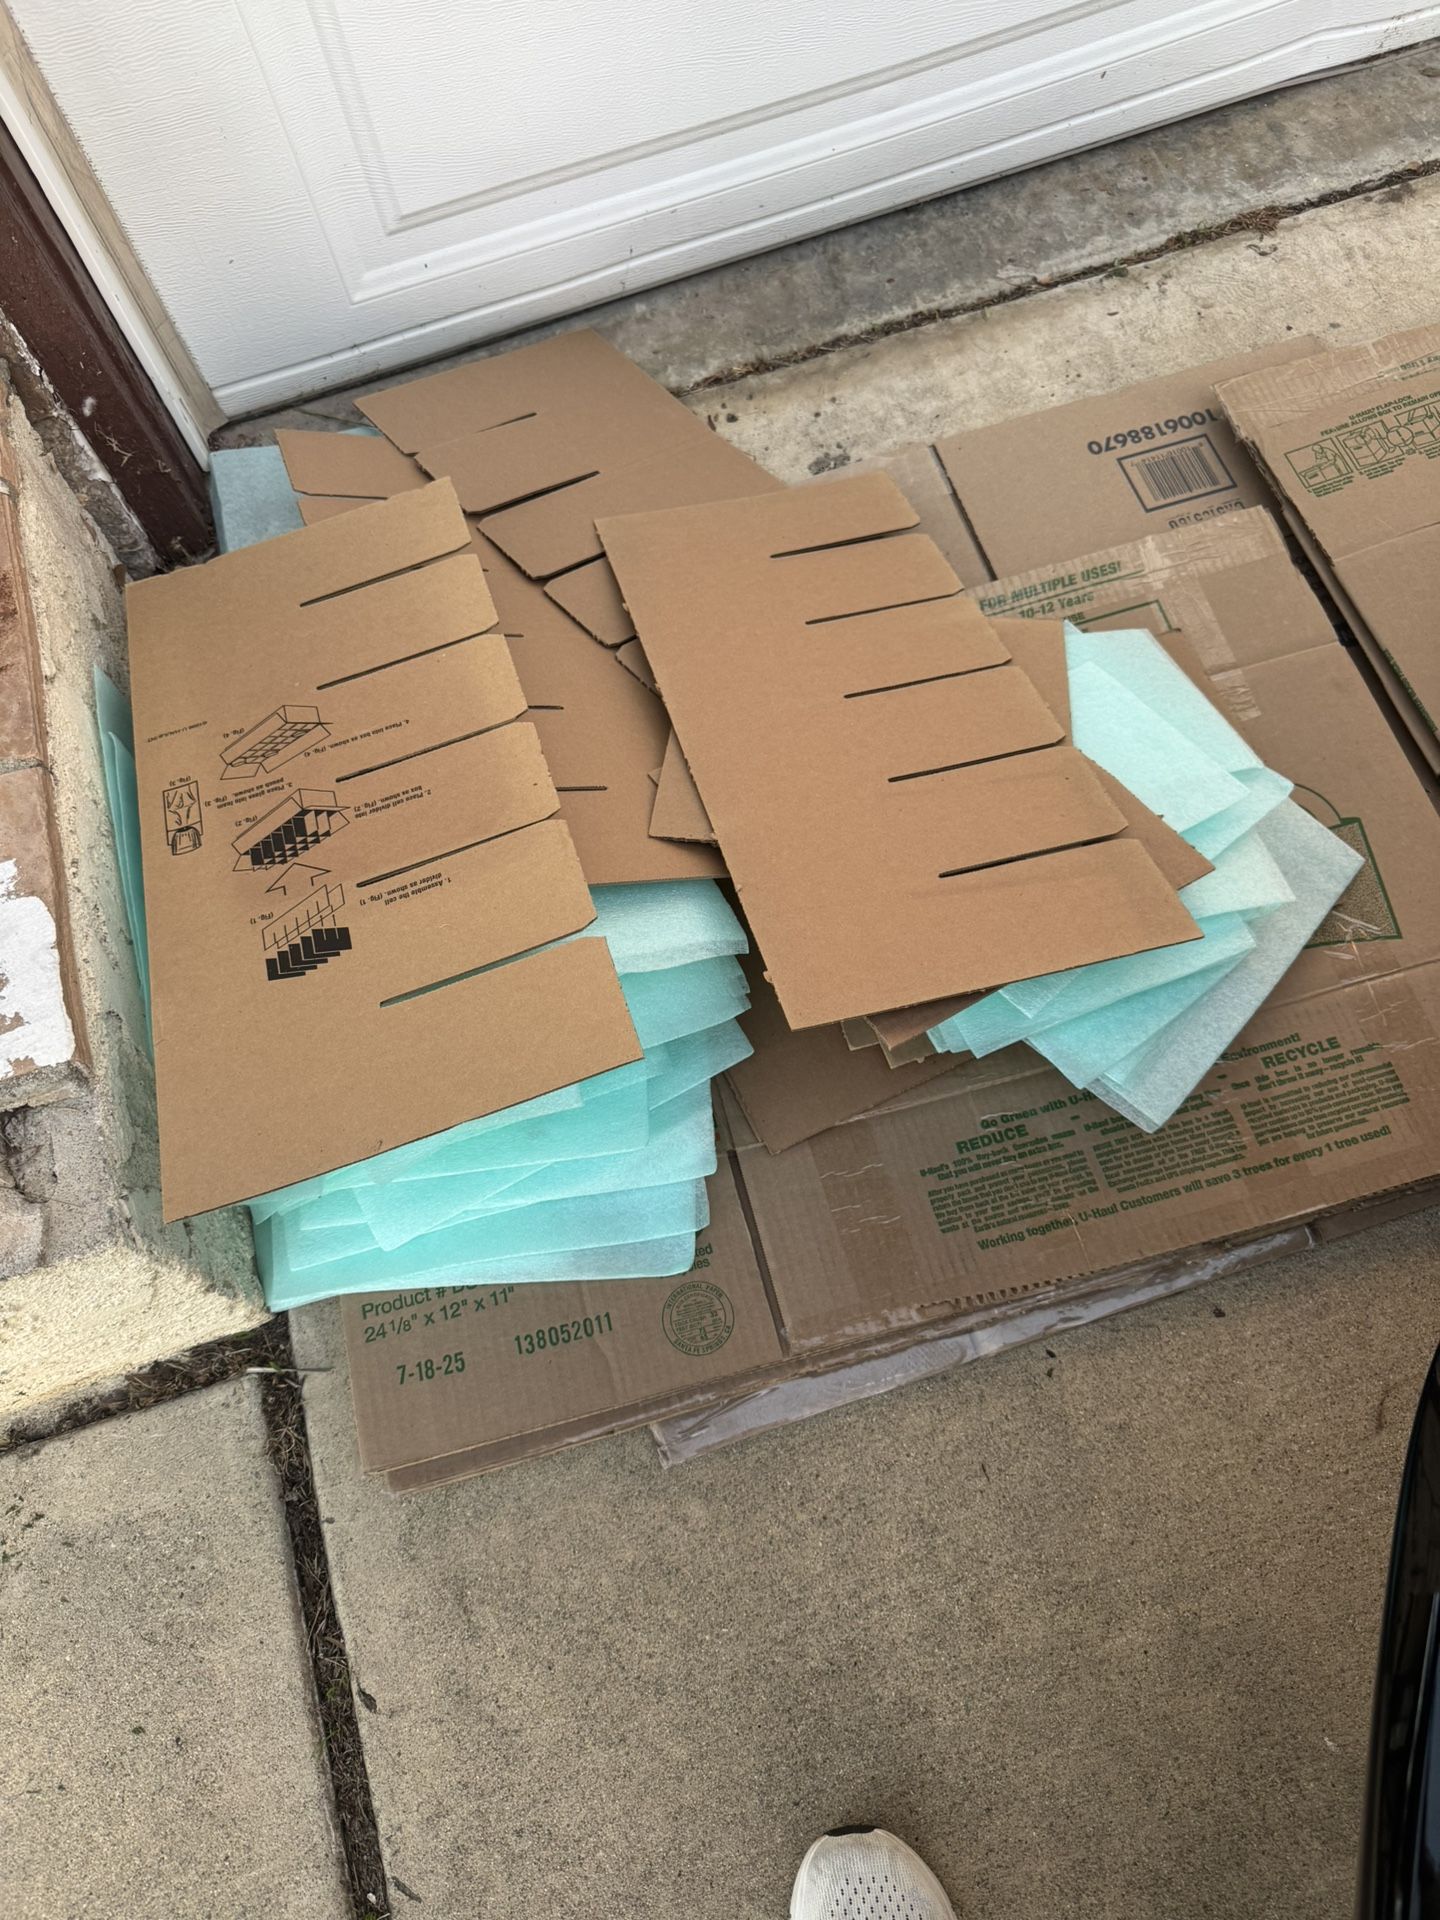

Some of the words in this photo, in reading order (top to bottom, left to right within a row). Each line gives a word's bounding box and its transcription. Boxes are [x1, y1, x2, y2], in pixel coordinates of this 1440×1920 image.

[1086, 406, 1217, 456] 1006188670
[979, 594, 1008, 610] FOR
[1012, 574, 1077, 602] MULTIPLE
[1081, 561, 1121, 582] USES!
[1060, 592, 1094, 609] Years
[410, 784, 422, 793] box
[423, 788, 431, 796] 2.
[377, 792, 400, 804] shown.
[392, 797, 404, 807] cell
[405, 791, 423, 802] Place
[353, 804, 361, 813] 2)
[361, 799, 376, 810] (Fig.
[368, 802, 390, 815] divider
[354, 810, 367, 819] into
[409, 880, 417, 888] as
[418, 871, 441, 886] divider
[444, 876, 450, 885] 1.
[384, 884, 407, 898] shown.
[410, 879, 443, 897] Assemble
[359, 897, 366, 907] 1)
[367, 891, 382, 904] (Fig.
[384, 895, 396, 906] cell
[398, 891, 409, 901] the
[1260, 1035, 1341, 1069] RECYCLE
[1000, 1107, 1037, 1124] Green
[1039, 1097, 1066, 1113] with
[955, 1123, 1028, 1154] REDUCE
[977, 1227, 1025, 1252] Working
[1078, 1201, 1119, 1223] U-Haul
[1119, 1185, 1181, 1212] Customers
[1182, 1177, 1203, 1194] will
[1204, 1170, 1231, 1187] save
[1231, 1167, 1241, 1179] 3
[1242, 1158, 1272, 1176] trees
[1273, 1154, 1290, 1168] for
[1292, 1145, 1323, 1164] every
[1325, 1141, 1333, 1152] 1
[1335, 1134, 1357, 1150] tree
[1359, 1124, 1391, 1143] used!
[361, 1287, 431, 1320] Product
[665, 1284, 702, 1310] INTERNATIONAL
[705, 1285, 723, 1299] PAPER
[422, 1311, 435, 1326] x
[438, 1298, 469, 1322] 12"
[473, 1296, 485, 1312] x
[488, 1284, 516, 1307] 11"
[513, 1311, 612, 1357] 138052011
[674, 1339, 694, 1353] SANTA
[395, 1350, 466, 1386] 7-18-25
